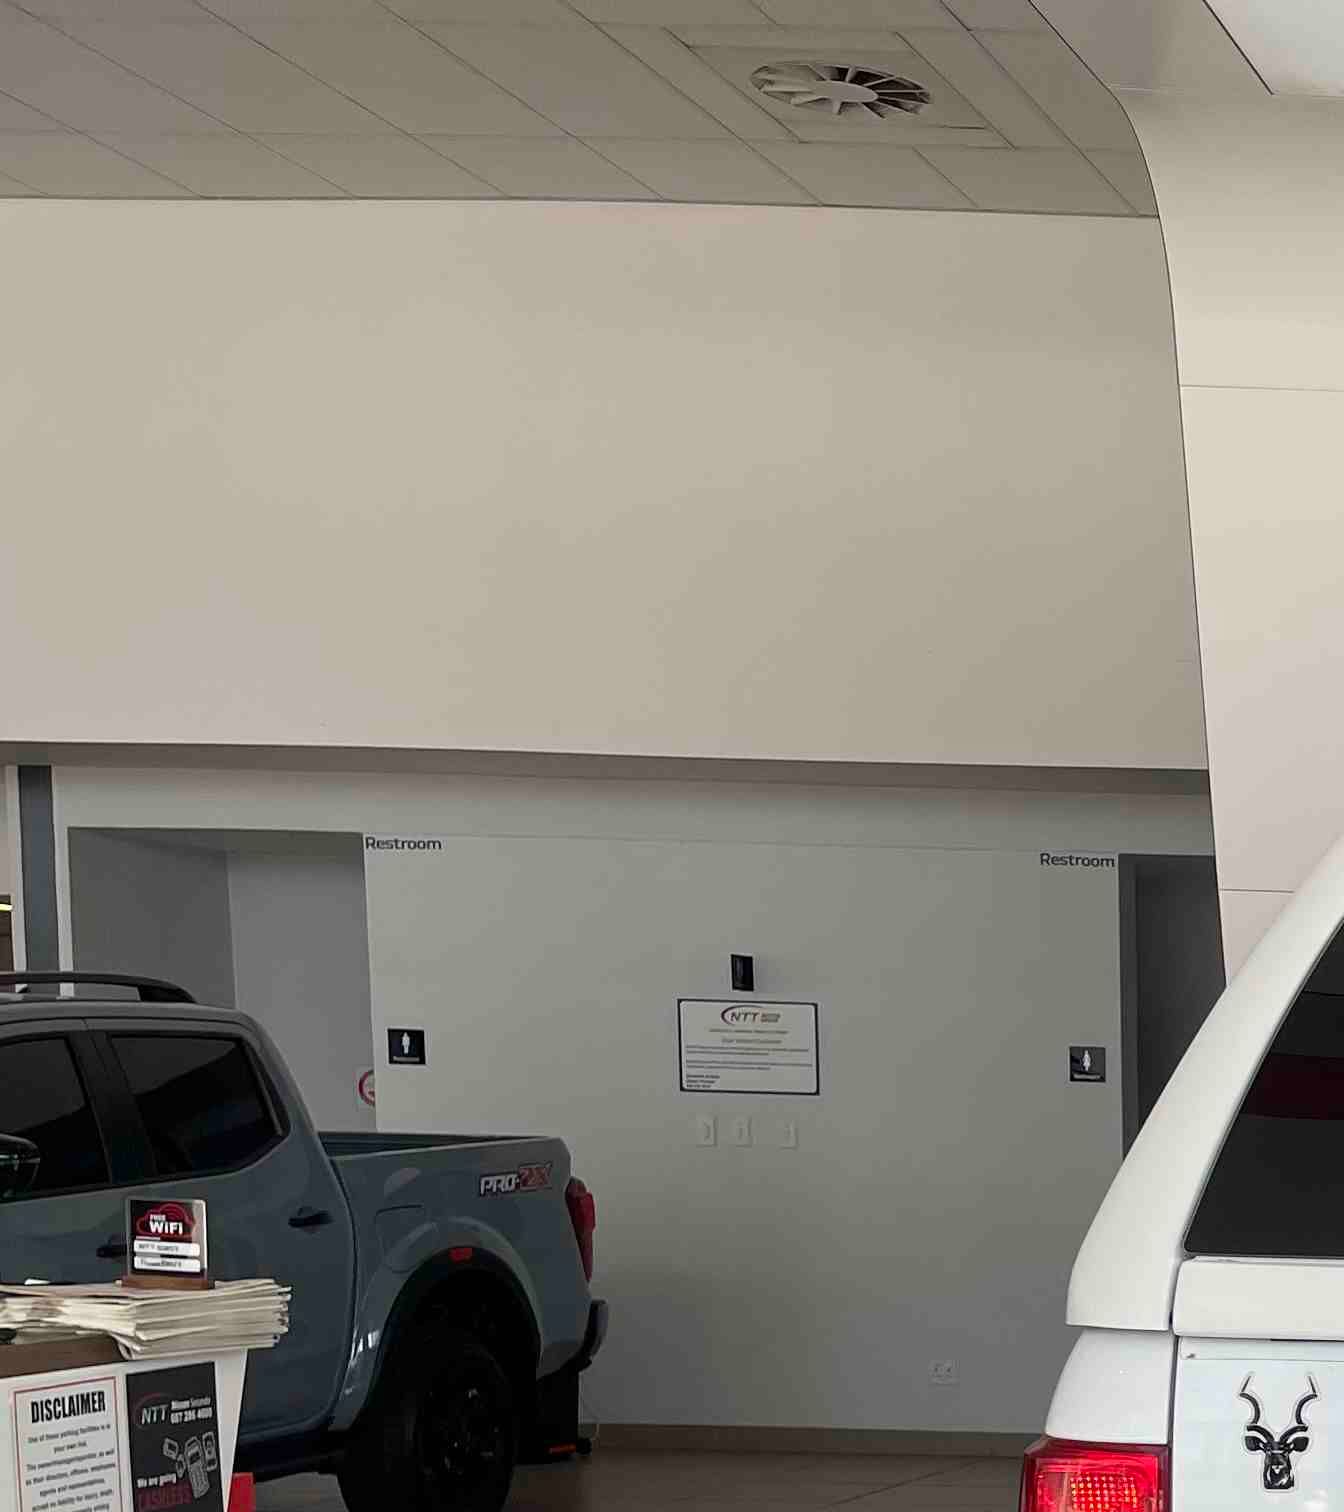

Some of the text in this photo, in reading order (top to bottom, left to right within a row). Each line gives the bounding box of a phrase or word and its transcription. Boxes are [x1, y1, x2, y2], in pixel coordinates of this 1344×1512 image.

[365, 836, 442, 850] Restroom
[1040, 853, 1115, 867] Restroom
[730, 1012, 759, 1022] NTT
[30, 1390, 105, 1423] DISCLAIMER
[142, 1405, 168, 1424] NTT
